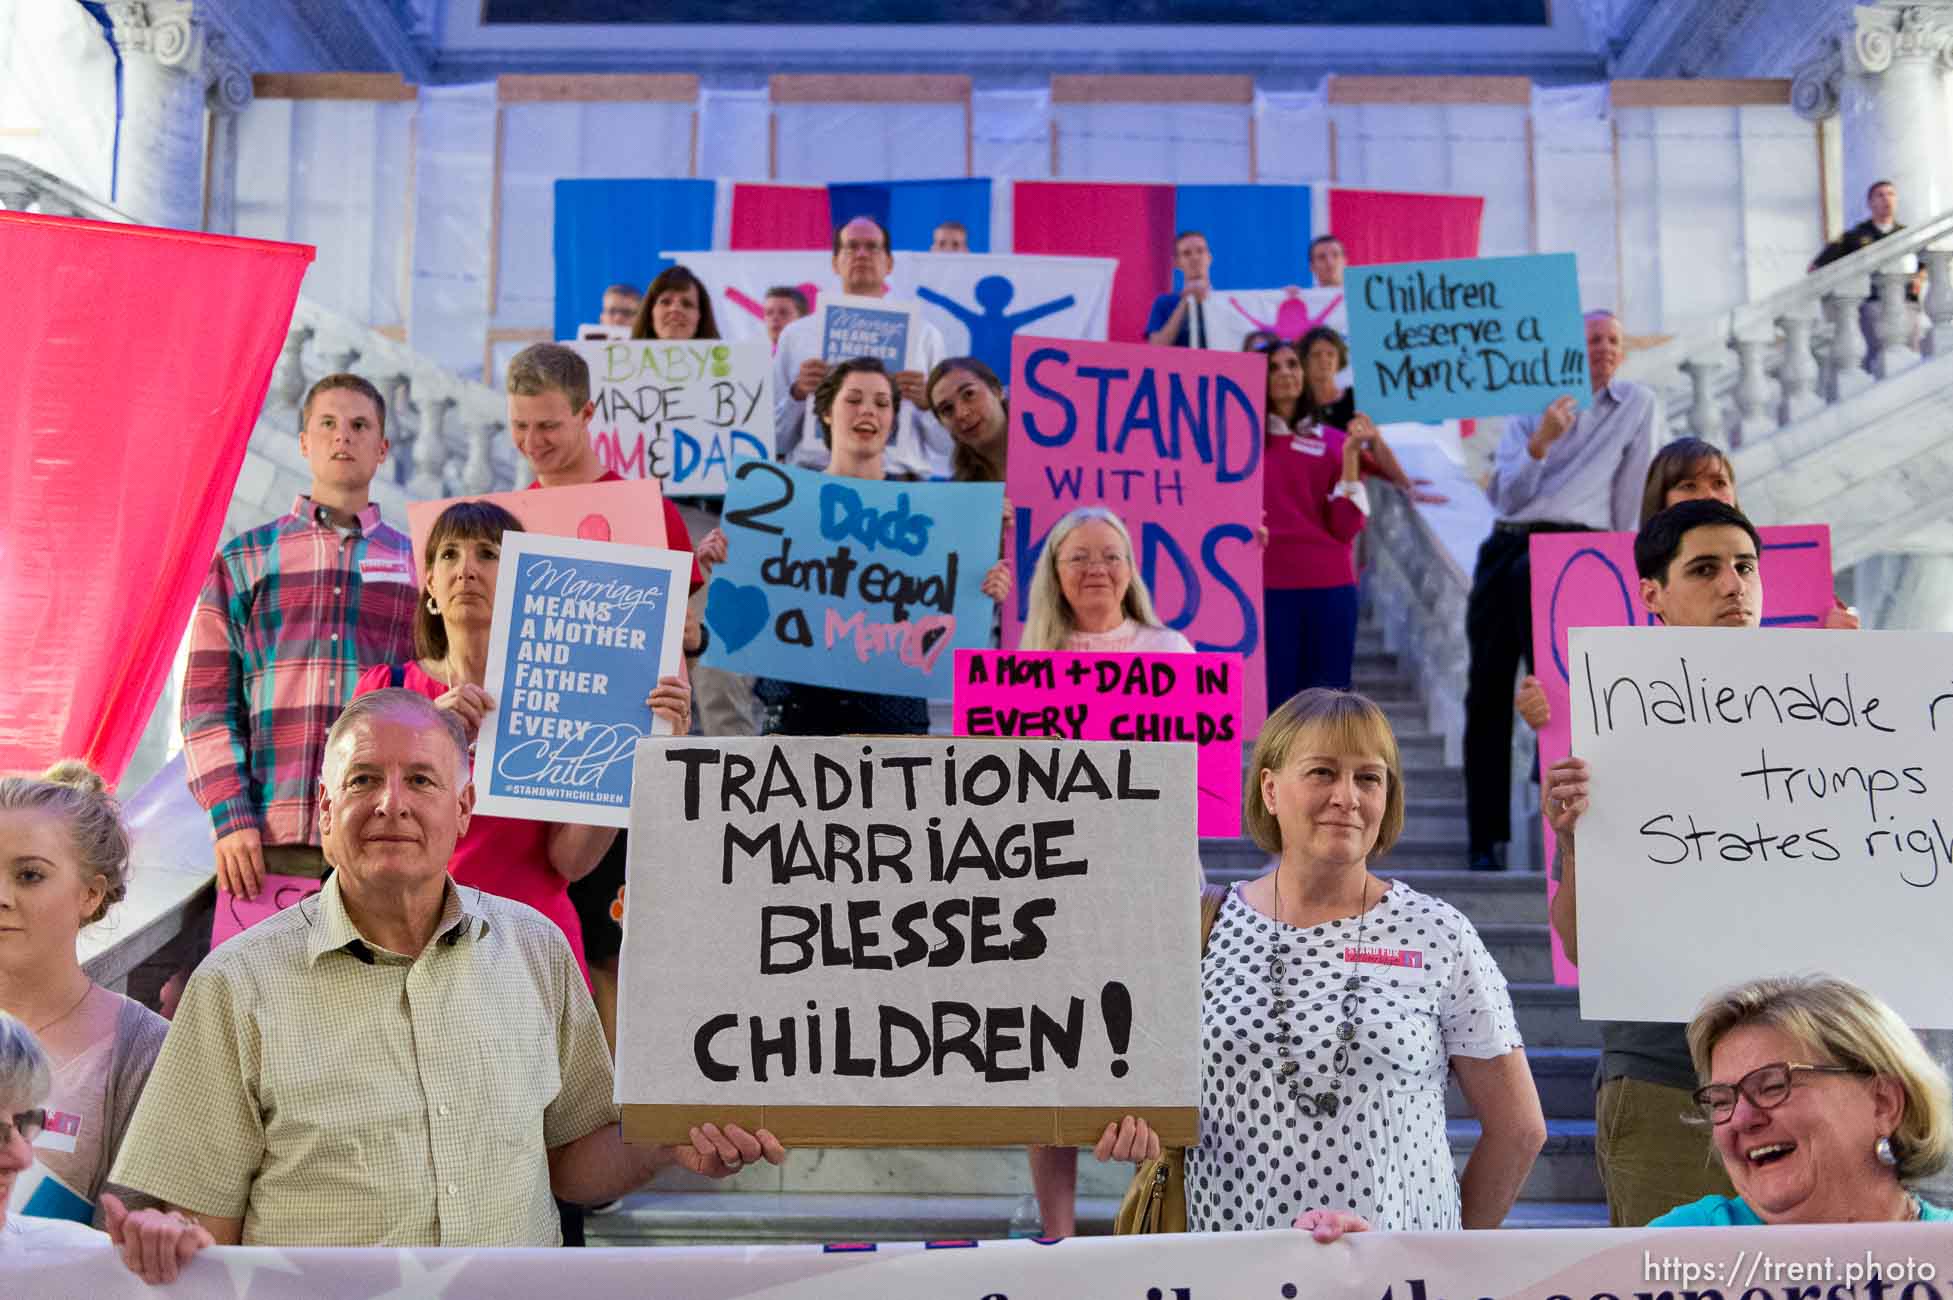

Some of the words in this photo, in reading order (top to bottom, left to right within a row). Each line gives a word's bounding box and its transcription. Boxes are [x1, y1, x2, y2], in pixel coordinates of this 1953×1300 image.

[1364, 271, 1502, 314] Children
[1384, 318, 1503, 351] deserve
[1517, 316, 1544, 342] a
[602, 345, 732, 383] BABY:
[1374, 354, 1456, 401] Mom
[704, 376, 764, 427] BY
[1022, 348, 1261, 484] STAND
[594, 428, 646, 480] OM
[1045, 466, 1184, 506] WITH
[725, 462, 794, 534] 2
[820, 483, 933, 556] Dads
[527, 559, 663, 630] Marriage
[858, 552, 957, 624] equal
[1015, 506, 1258, 658] KDS
[523, 594, 611, 621] MEANS
[775, 609, 813, 647] a
[518, 641, 569, 663] AND
[520, 619, 536, 639] A
[544, 617, 646, 650] MOTHER
[515, 664, 609, 695] FATHER
[969, 655, 988, 685] A
[1066, 660, 1091, 685] +
[1095, 657, 1176, 697] DAD
[1197, 663, 1229, 695] IN
[1585, 651, 1896, 735] Inalienable
[1929, 680, 1953, 730] r
[511, 688, 560, 713] FOR
[509, 712, 590, 741] EVERY
[966, 704, 1088, 741] EVERY
[1110, 711, 1234, 746] CHILDS
[498, 723, 643, 788] Child
[504, 783, 624, 804] #STANDWITHCHILDREN
[1741, 748, 1928, 822] trumps
[1640, 814, 1841, 865] States
[760, 897, 1056, 974] BLESSES
